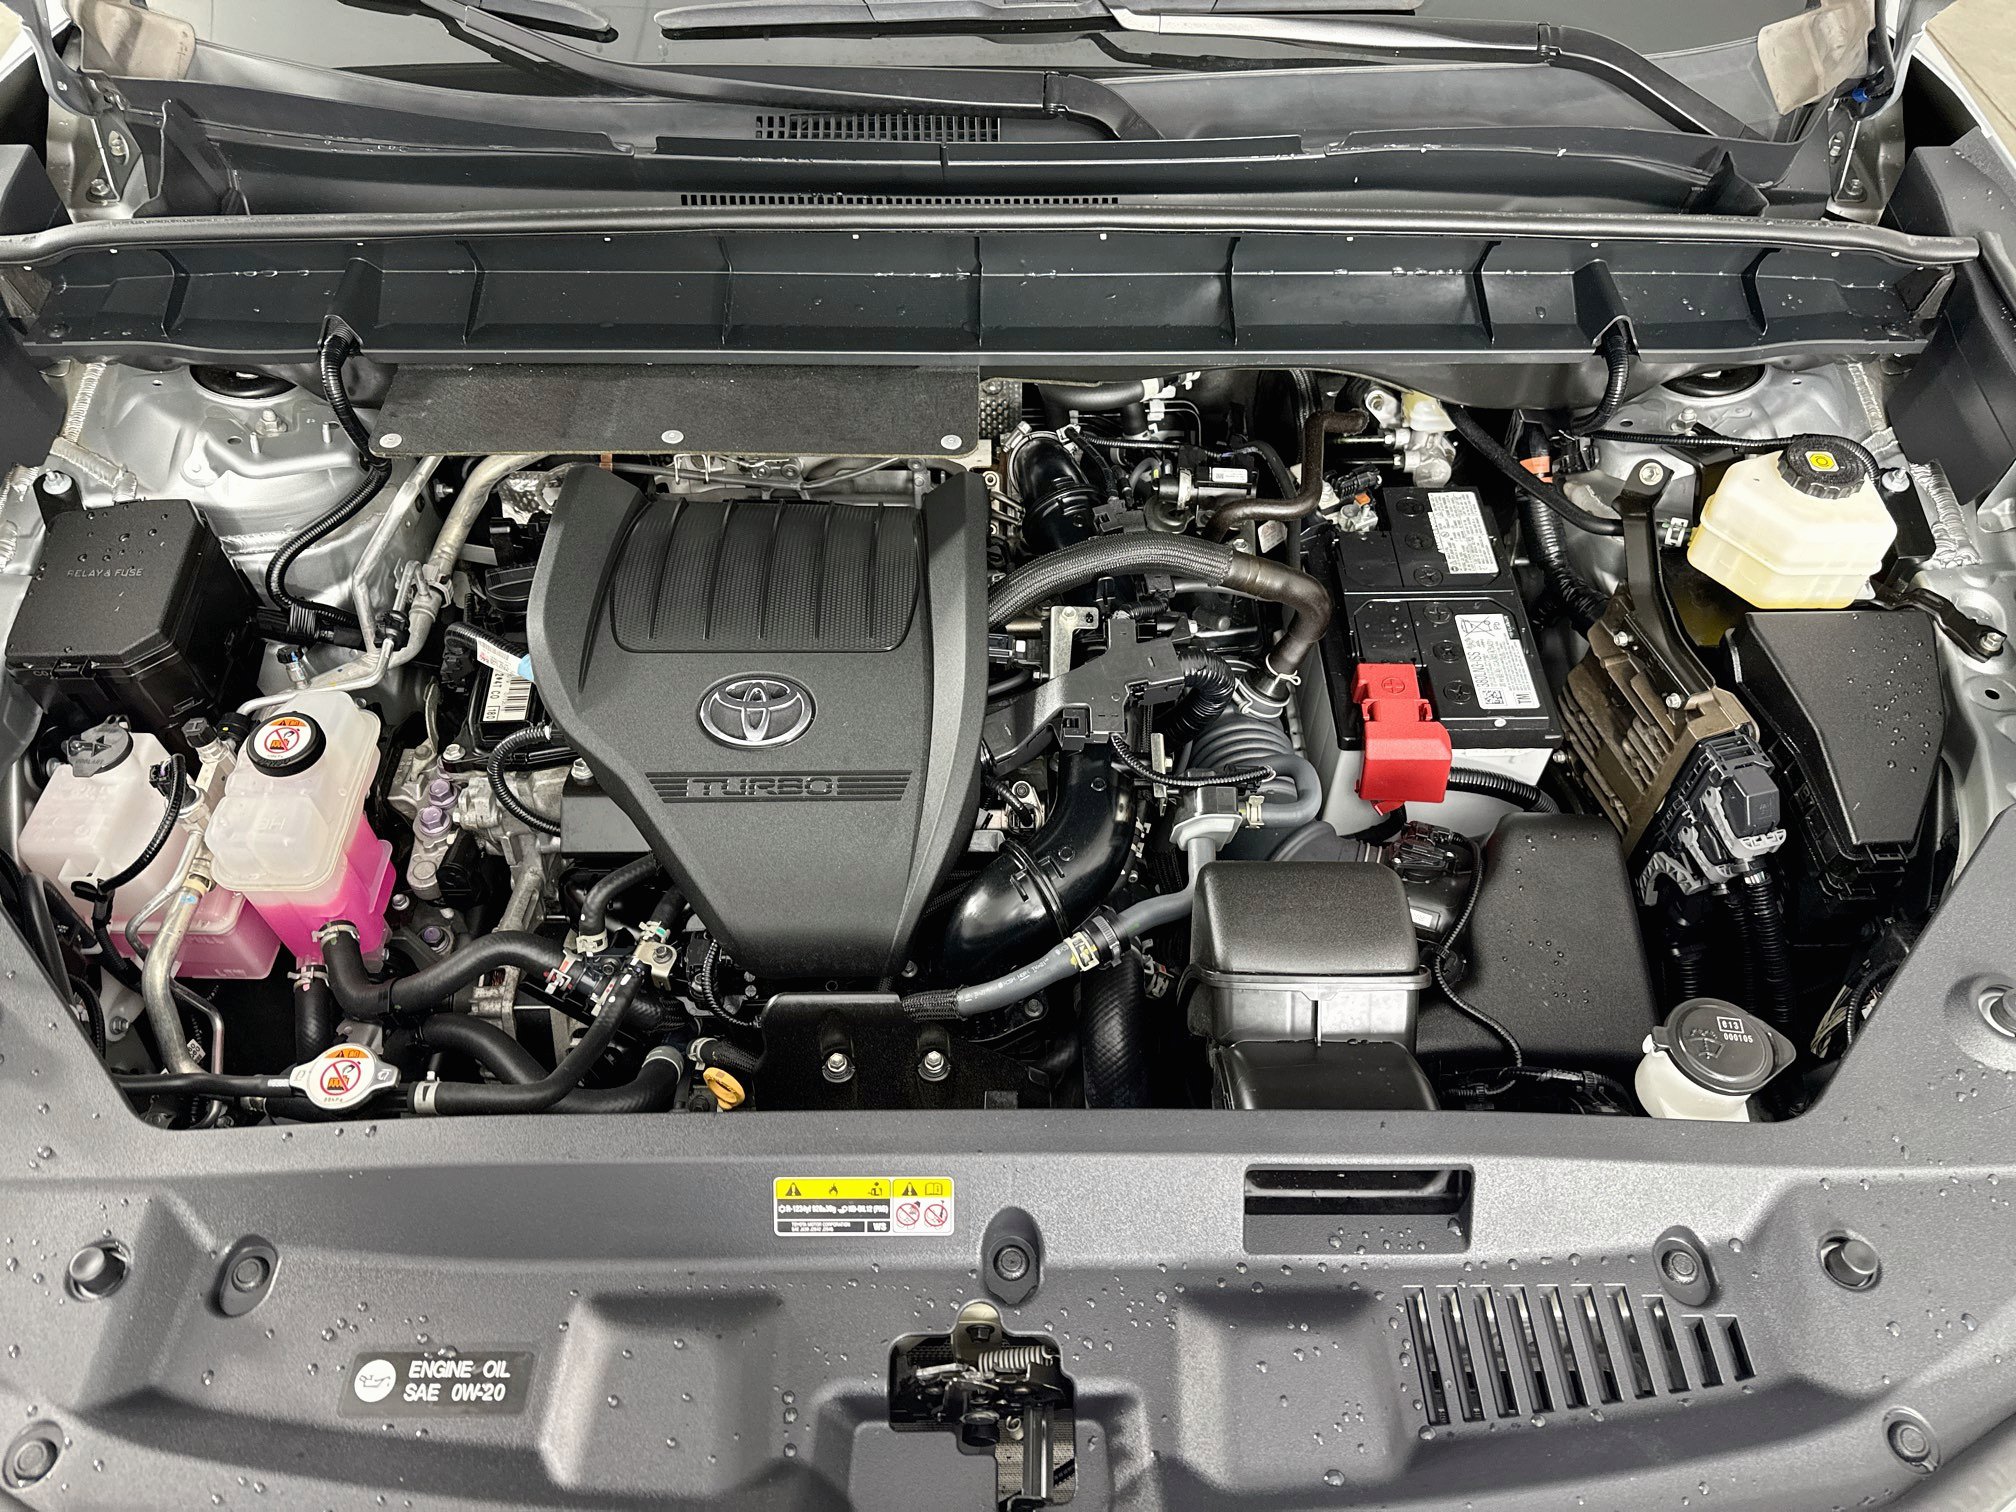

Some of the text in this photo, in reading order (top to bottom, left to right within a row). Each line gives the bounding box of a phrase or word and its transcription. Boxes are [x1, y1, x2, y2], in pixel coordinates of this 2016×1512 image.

[67, 569, 103, 578] RELAY
[114, 568, 144, 577] FUSE
[1516, 693, 1532, 705] TM
[691, 776, 833, 796] TURBO
[1723, 1032, 1754, 1044] 000105
[408, 1360, 511, 1379] ENGINE OIL
[403, 1382, 506, 1402] SAE 0W-20
